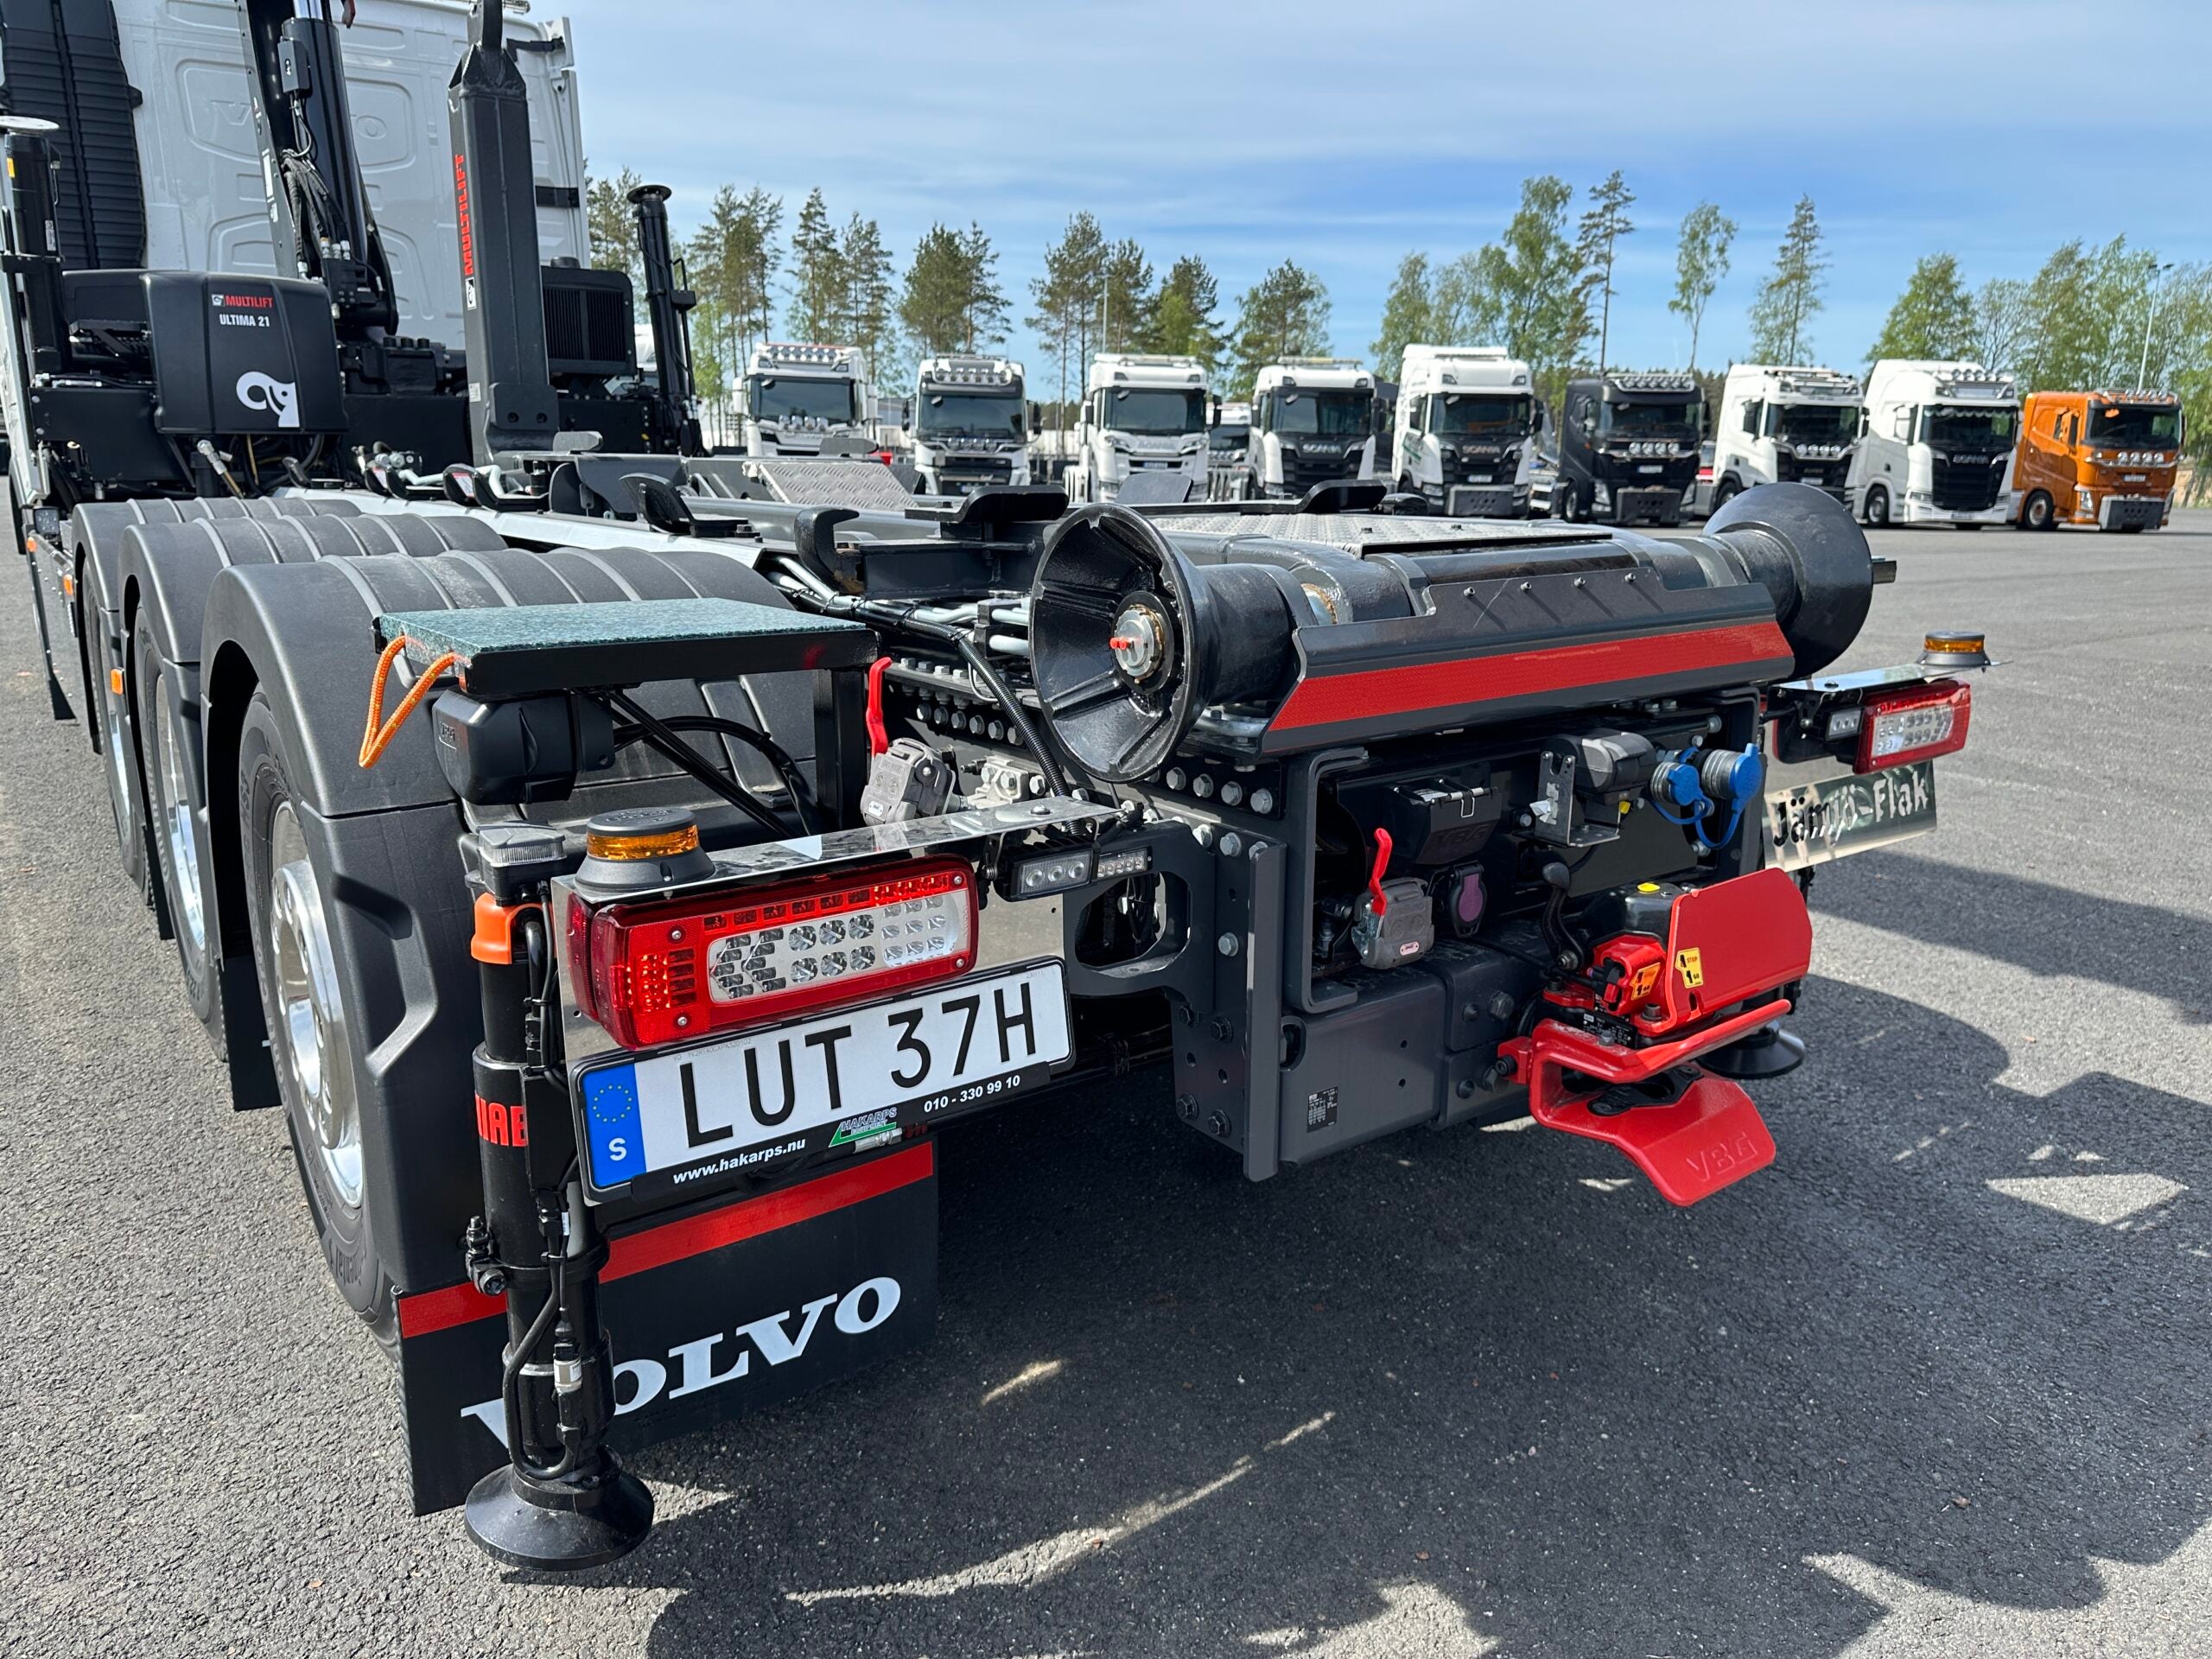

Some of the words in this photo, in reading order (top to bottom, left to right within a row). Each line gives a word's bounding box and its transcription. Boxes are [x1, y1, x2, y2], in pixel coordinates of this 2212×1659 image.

[455, 154, 474, 276] MULTILIFT
[219, 314, 256, 327] ULTIMA
[257, 316, 270, 327] 21
[225, 295, 274, 308] MULTILIFT
[679, 1026, 852, 1148] LUT
[888, 982, 1037, 1090] 37H
[924, 1096, 949, 1113] 010
[960, 1086, 983, 1103] 330
[987, 1080, 1002, 1095] 99
[1006, 1075, 1021, 1089] 10
[474, 1091, 529, 1147] IAB
[842, 1107, 898, 1132] HAKARPS
[608, 1137, 627, 1162] S
[672, 1138, 807, 1185] www.hakarps.nu
